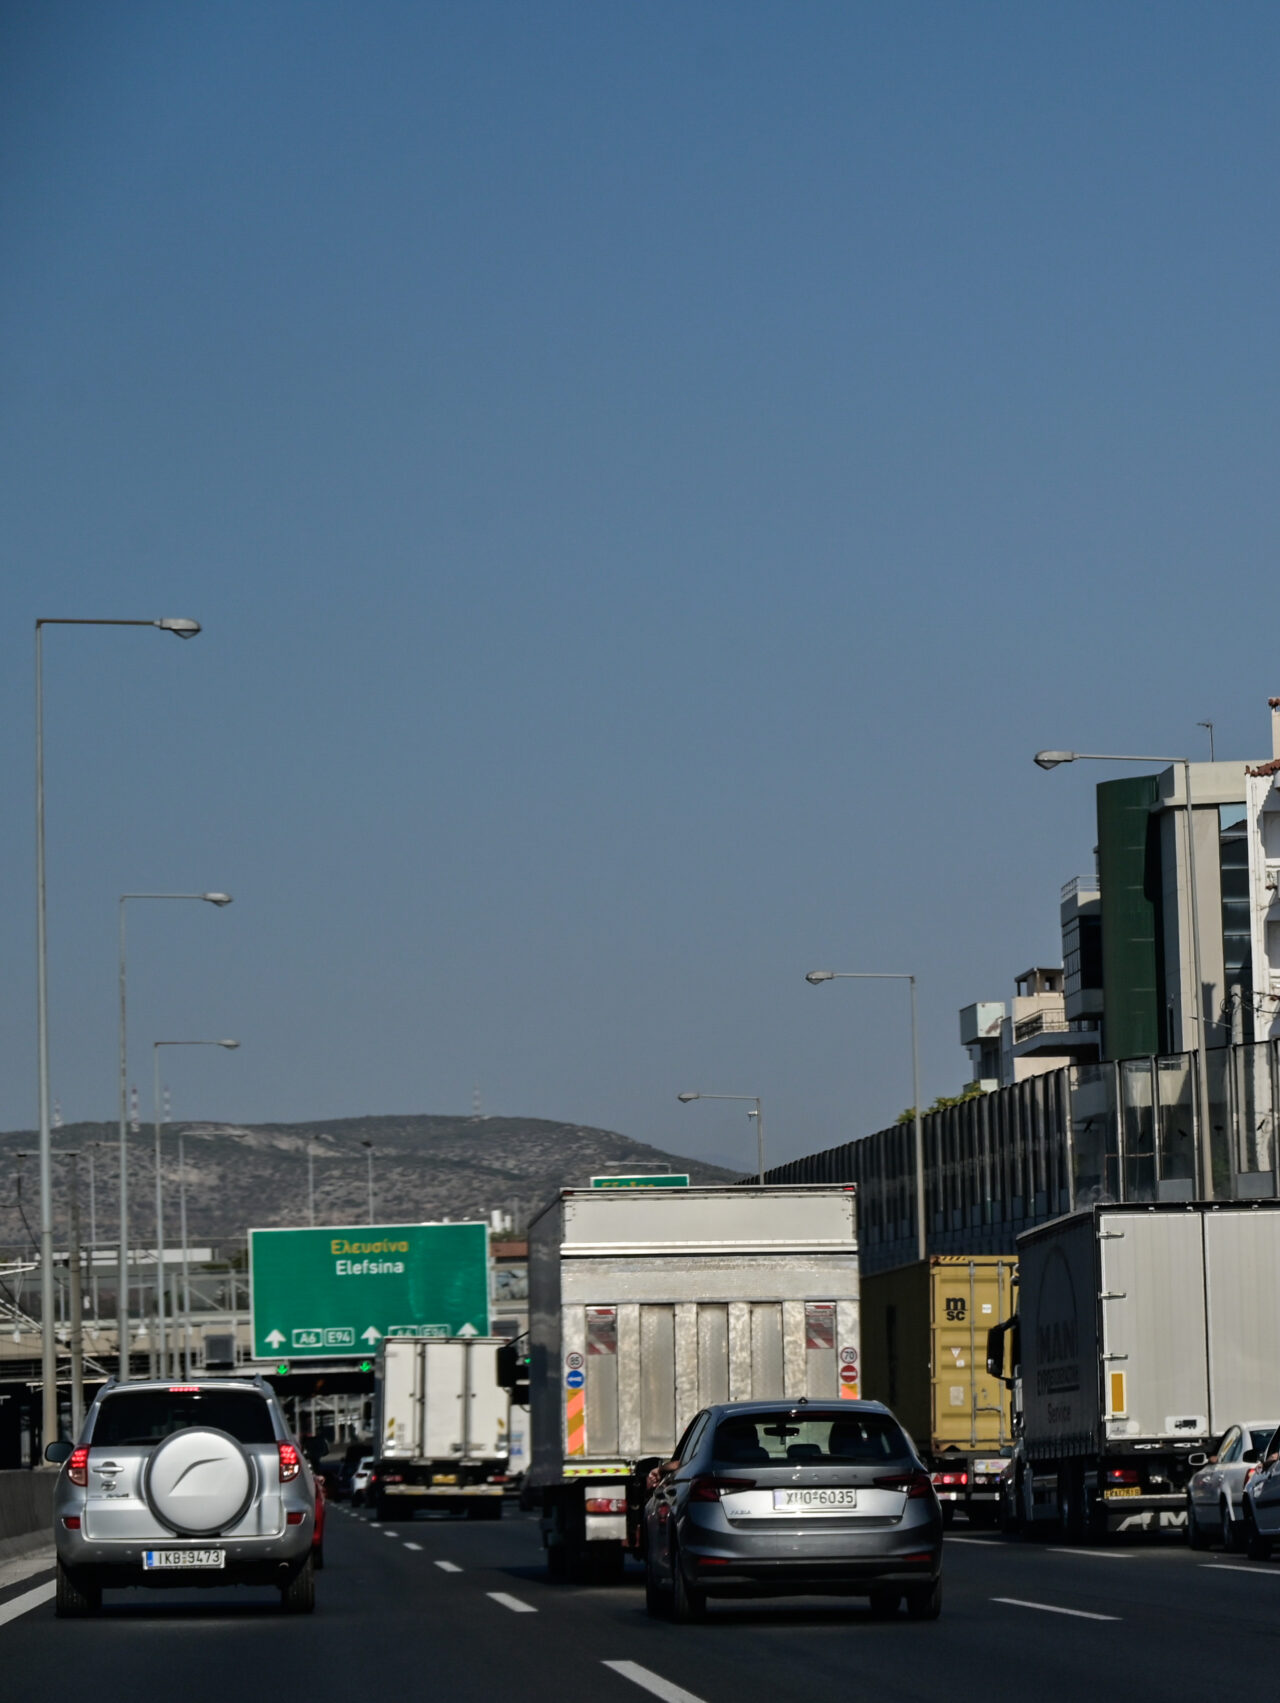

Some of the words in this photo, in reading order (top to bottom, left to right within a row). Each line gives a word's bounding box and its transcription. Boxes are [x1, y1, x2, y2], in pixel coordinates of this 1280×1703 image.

[336, 1259, 404, 1275] Elefsina
[300, 1333, 317, 1344] A6
[328, 1331, 351, 1343] E94
[845, 1351, 854, 1360] 70
